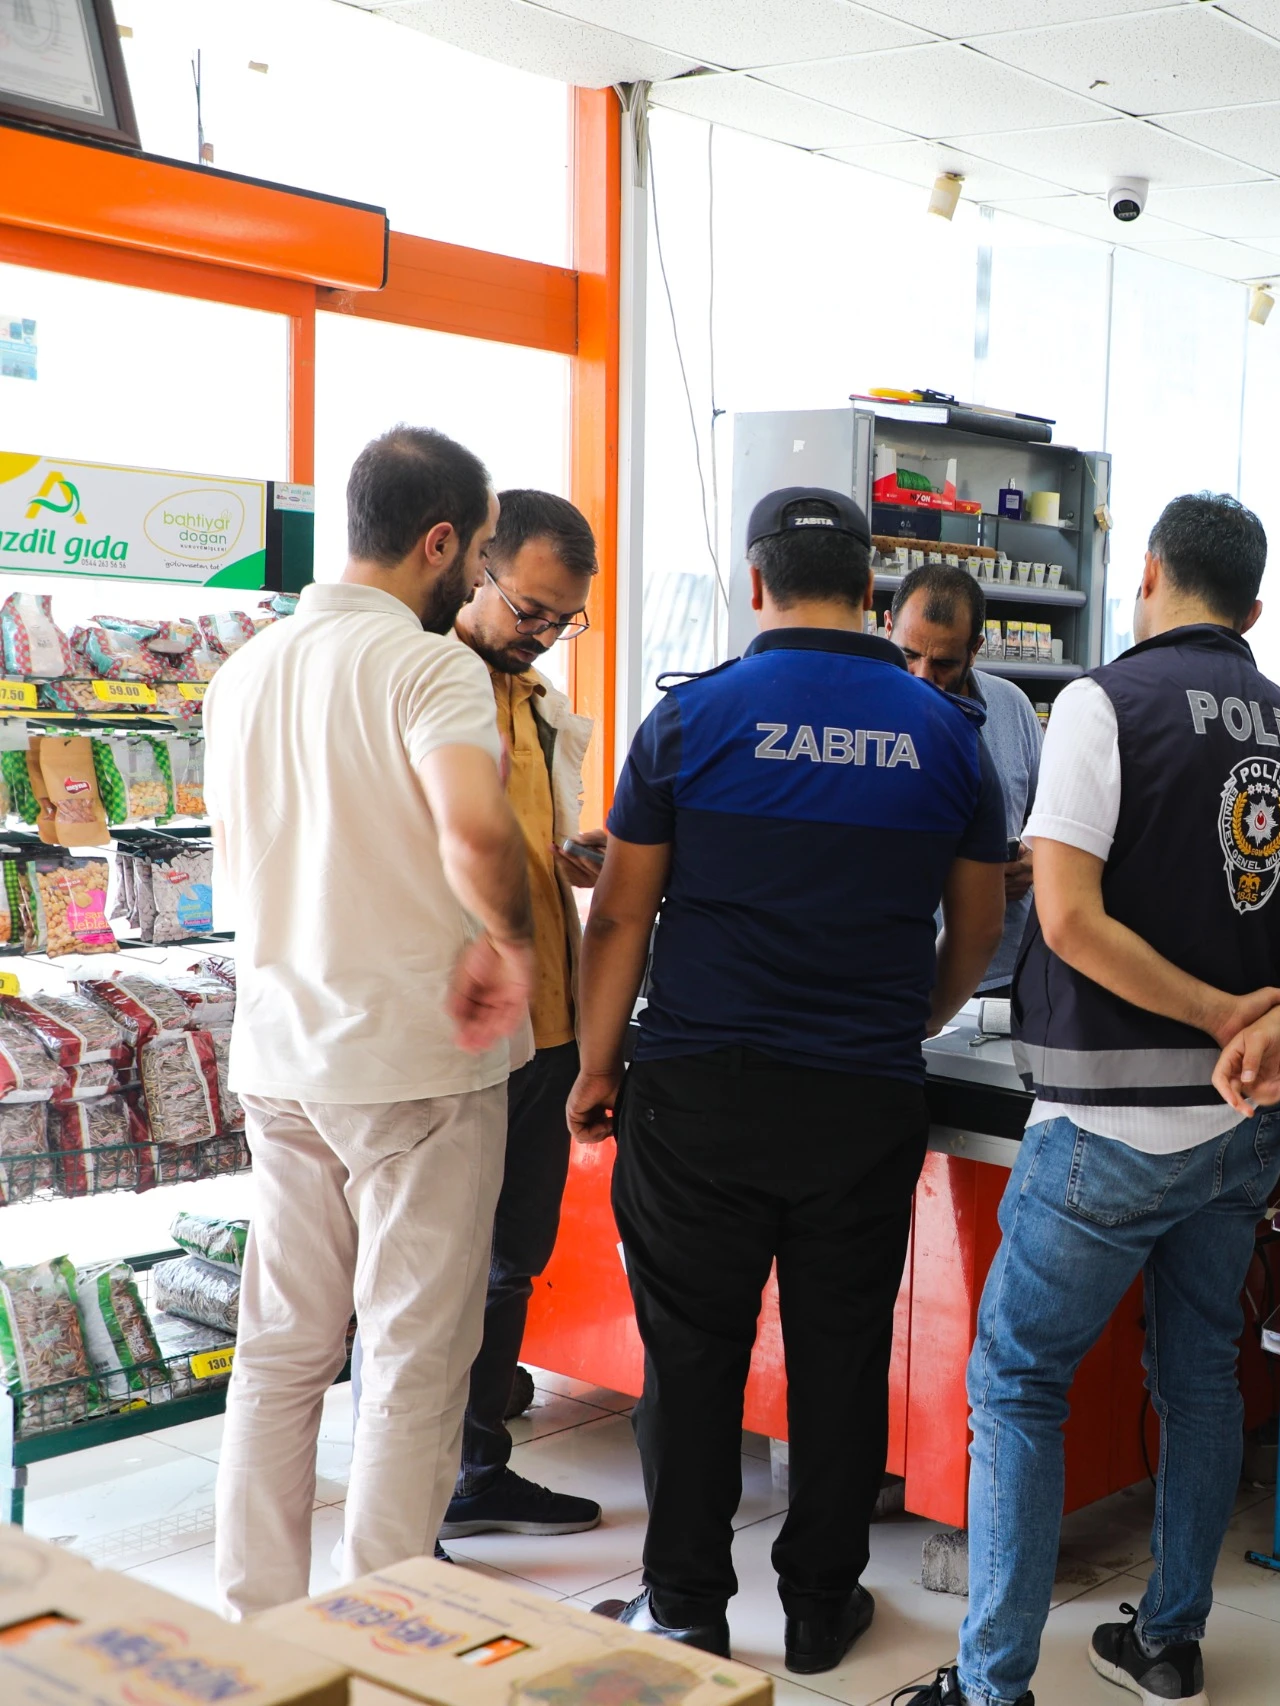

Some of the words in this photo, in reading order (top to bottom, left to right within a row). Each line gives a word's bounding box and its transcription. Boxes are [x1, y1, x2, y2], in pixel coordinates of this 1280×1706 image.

[163, 510, 231, 531] bahtiyar
[795, 517, 835, 527] ZABITA
[179, 530, 227, 546] doğan
[0, 528, 57, 555] zdil
[63, 535, 129, 565] gıda
[81, 559, 97, 568] 0544
[98, 559, 109, 568] 263
[110, 560, 118, 569] 56
[119, 561, 127, 569] 56
[109, 685, 140, 697] 59.00
[755, 723, 921, 769] ZABITA
[1232, 848, 1262, 870] GENEL
[1236, 892, 1259, 902] 1845
